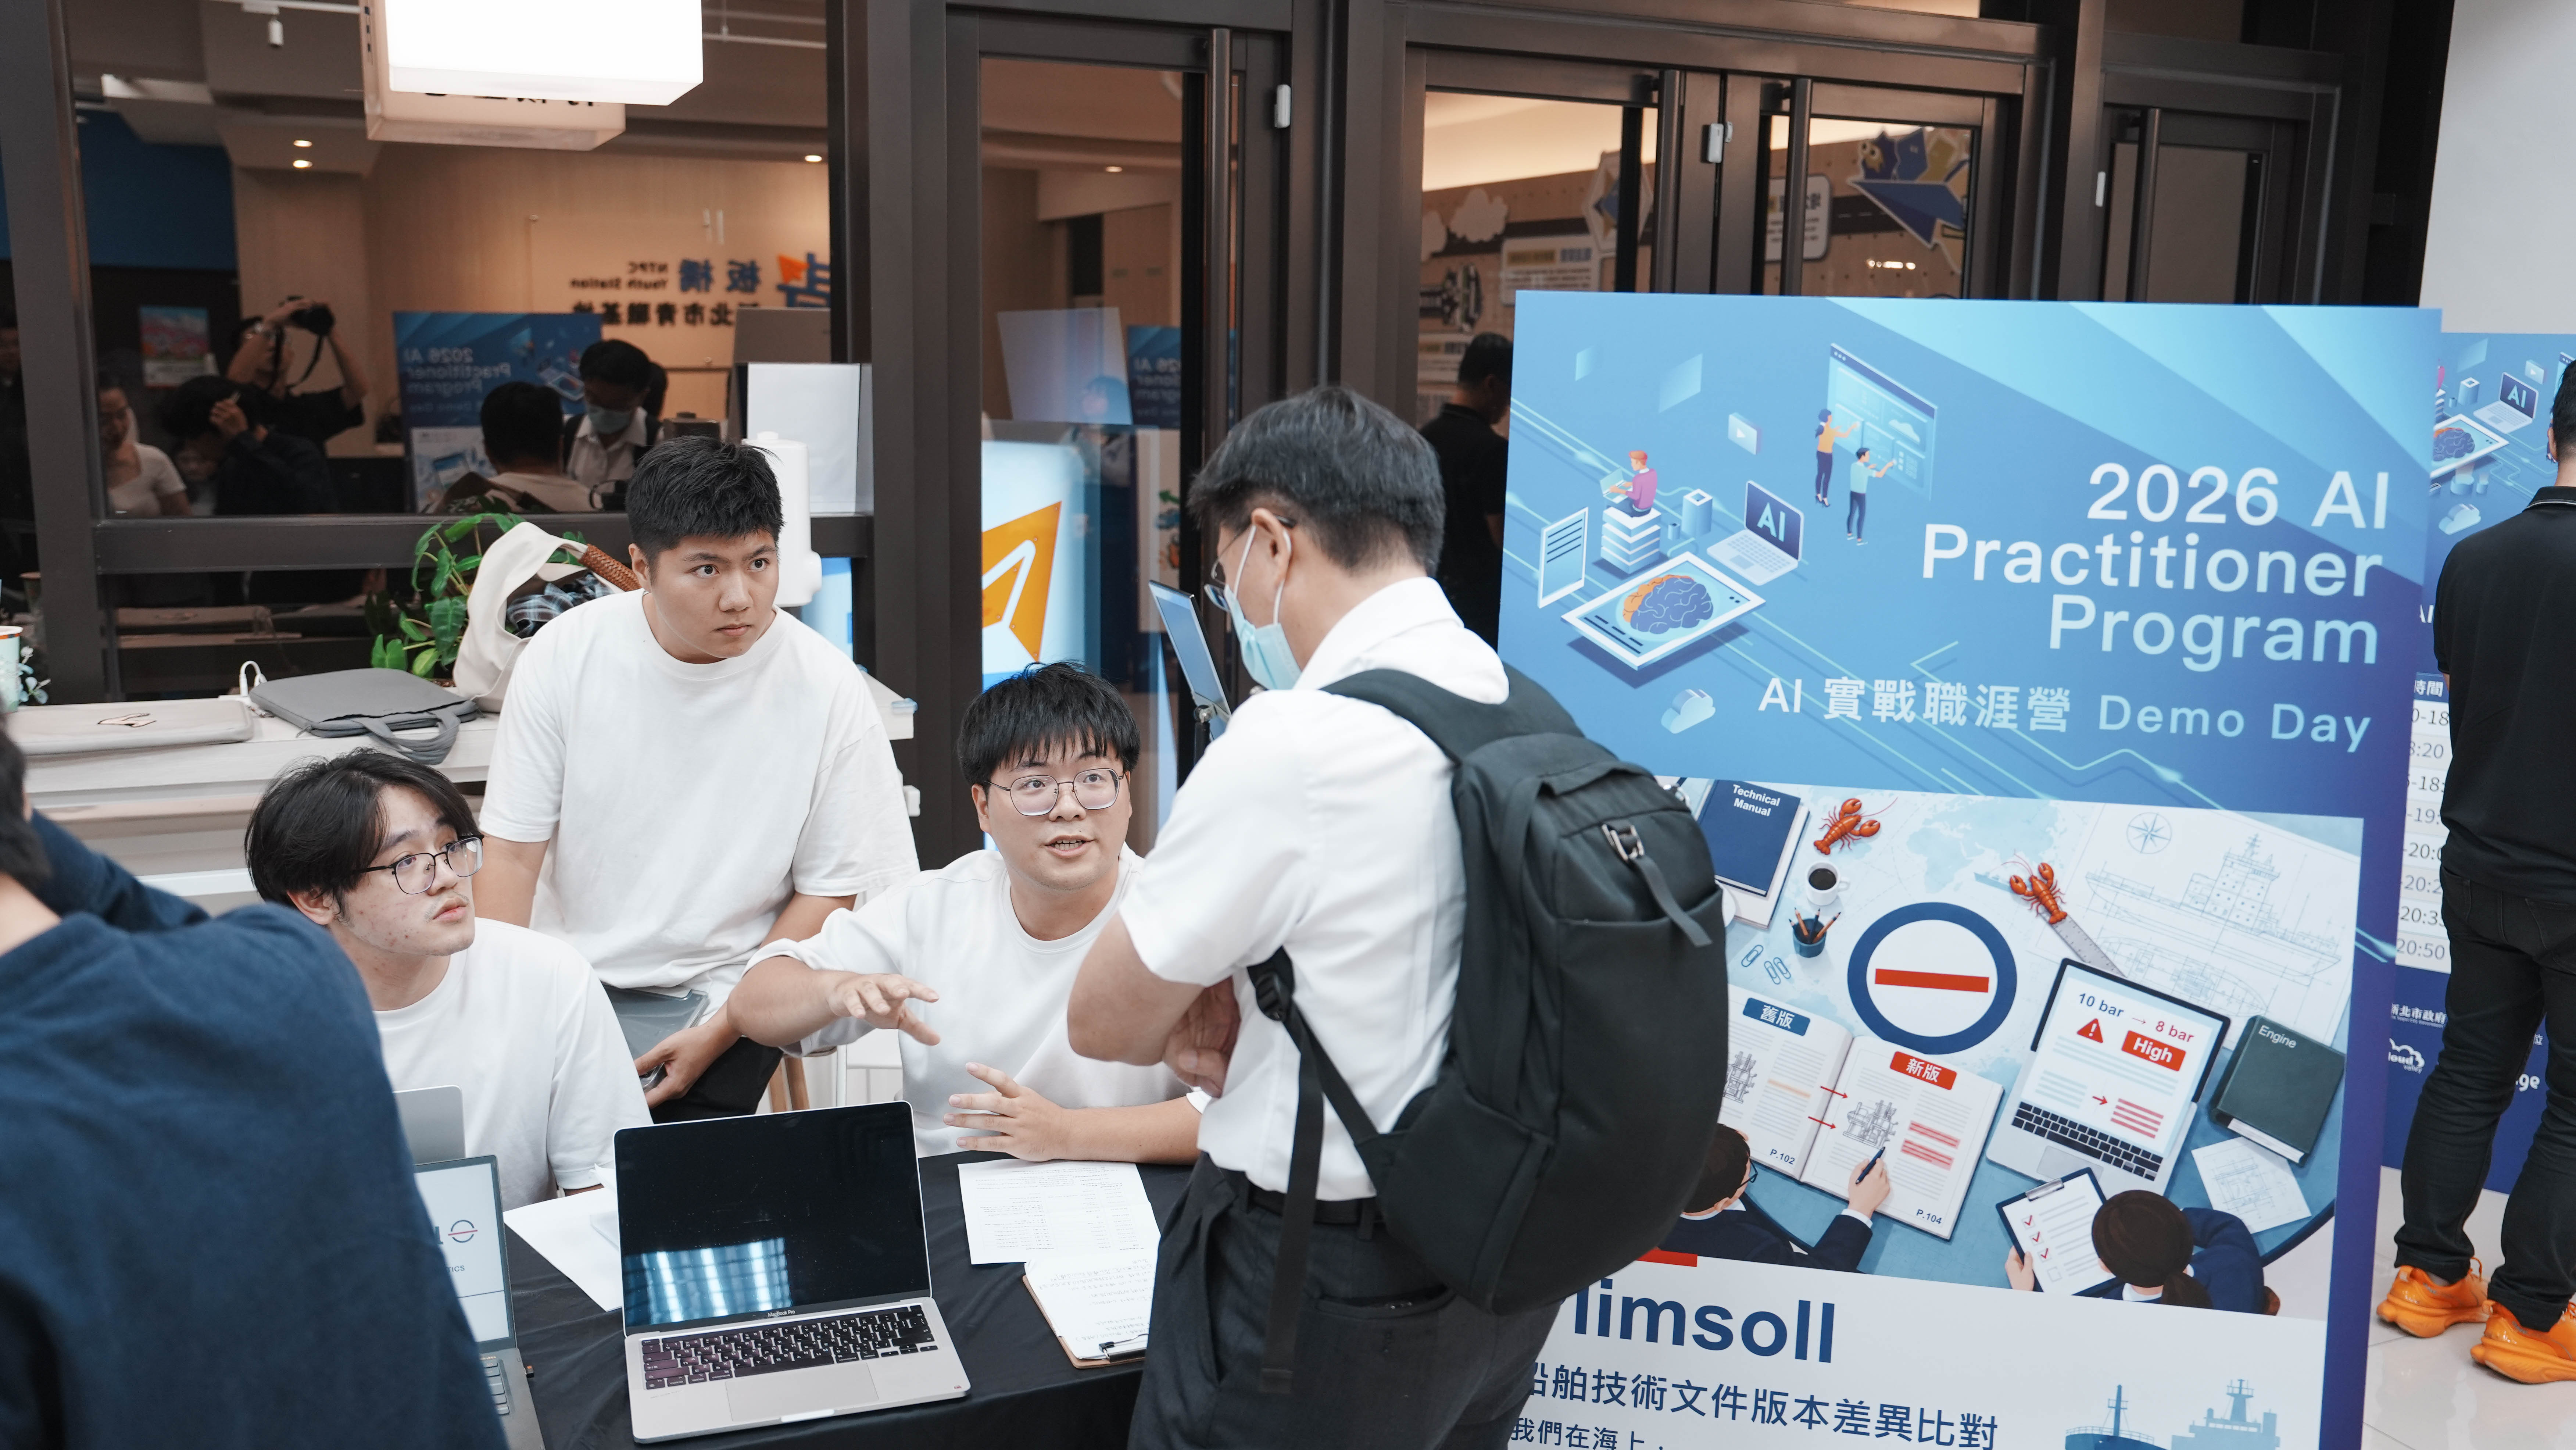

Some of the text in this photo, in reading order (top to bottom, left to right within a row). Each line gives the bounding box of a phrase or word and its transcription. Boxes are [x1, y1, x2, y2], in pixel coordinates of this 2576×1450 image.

[2507, 385, 2527, 409] AI
[2087, 462, 2389, 529] 2026 AI
[1757, 502, 1786, 542] AI
[1923, 523, 2383, 596] Practitioner
[2050, 594, 2378, 672] Program
[1758, 677, 2372, 753] AI 實戰職涯營 Demo Day
[1733, 784, 1781, 807] Technical
[1734, 798, 1771, 817] Manual
[1760, 1005, 1795, 1029] 舊版
[2079, 993, 2194, 1043] 10 bar 8 bar
[2258, 1024, 2297, 1049] Engine
[2132, 1038, 2174, 1063] High
[1906, 1058, 1942, 1083] 新版
[2516, 1074, 2540, 1092] ge
[1770, 1148, 1796, 1165] P.102
[1916, 1208, 1942, 1226] P.104
[1561, 1278, 1835, 1363] limsoll
